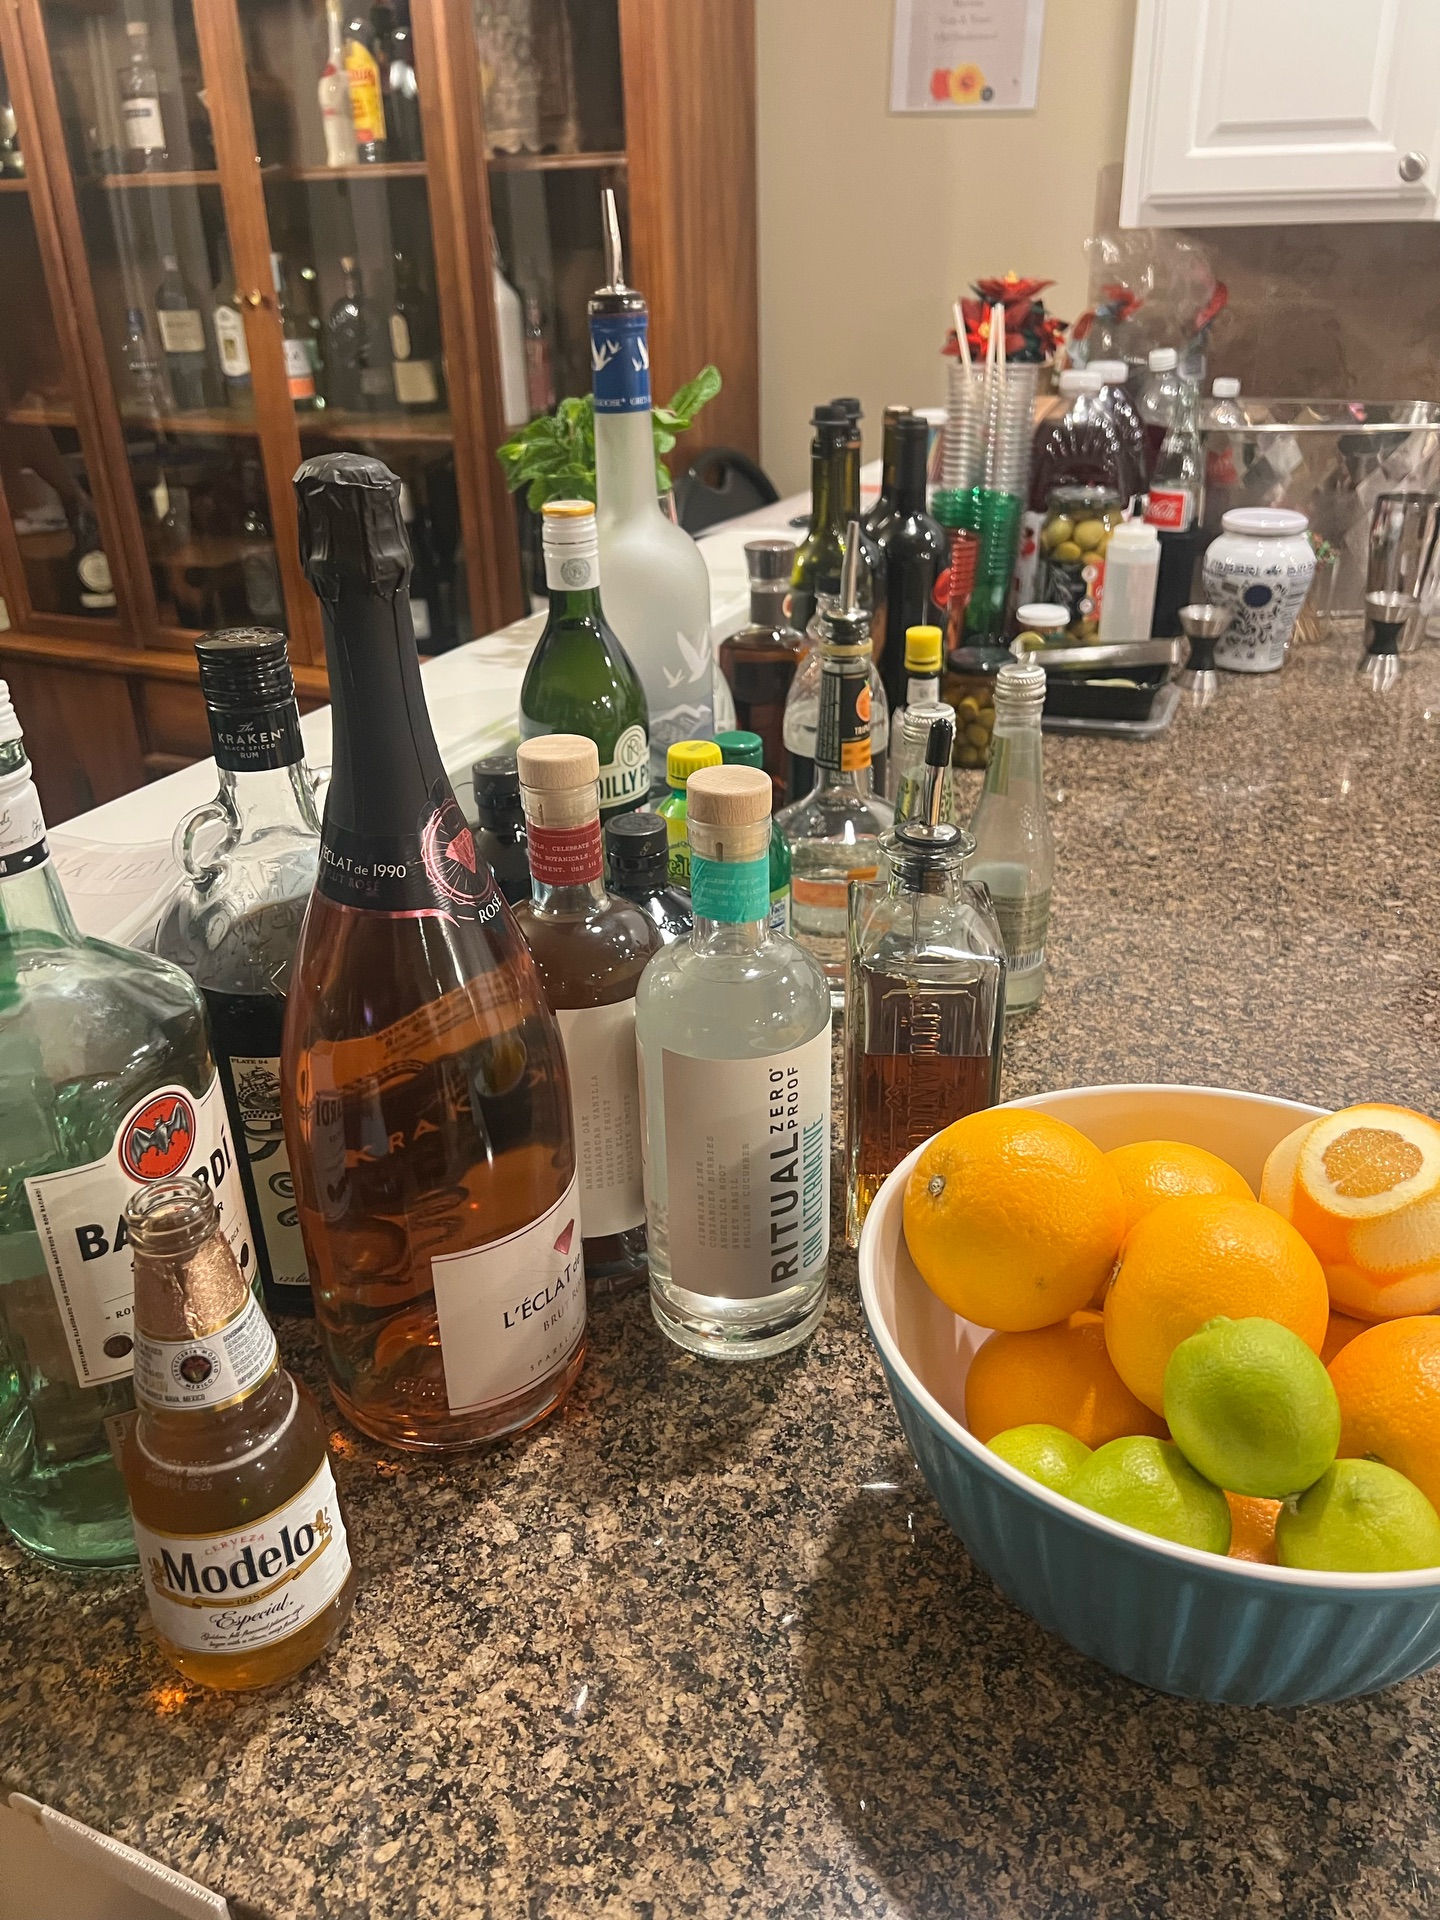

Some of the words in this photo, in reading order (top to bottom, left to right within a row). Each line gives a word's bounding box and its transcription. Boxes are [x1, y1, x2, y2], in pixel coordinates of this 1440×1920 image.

[217, 729, 283, 744] KRAKEN
[237, 721, 255, 732] The
[249, 743, 276, 752] SPICED
[545, 852, 592, 863] BOTANICALS.
[551, 841, 590, 852] CELEBRATE
[354, 865, 369, 876] de
[373, 863, 407, 879] 1990
[570, 865, 585, 873] USE
[477, 891, 503, 924] ROSÉ
[591, 1075, 601, 1120] VANILLA
[787, 1067, 799, 1129] PROOF
[582, 1115, 590, 1134] OAK
[603, 1099, 612, 1131] FRUIT
[582, 1140, 593, 1190] AMERICAN
[593, 1127, 604, 1189] MADAGASCAR
[706, 1135, 715, 1183] BERRIES
[742, 1142, 751, 1197] CUCUMBER
[803, 1112, 824, 1232] ALTERNATIVE
[718, 1164, 727, 1190] ROOT
[731, 1178, 739, 1210] BASIL
[770, 1131, 799, 1284] RITUAL
[707, 1190, 717, 1248] CORIANDER
[719, 1197, 728, 1249] ANGELICA
[803, 1227, 823, 1269] GIN
[502, 1263, 572, 1330] L'ÉCLAT
[543, 1300, 570, 1332] BRUT
[201, 1350, 219, 1374] MODELO
[183, 1393, 206, 1403] MEXICO
[185, 1378, 213, 1389] MEXICO
[160, 1523, 315, 1594] Modelo
[205, 1533, 265, 1556] CERVEZA
[236, 1594, 260, 1606] 1925
